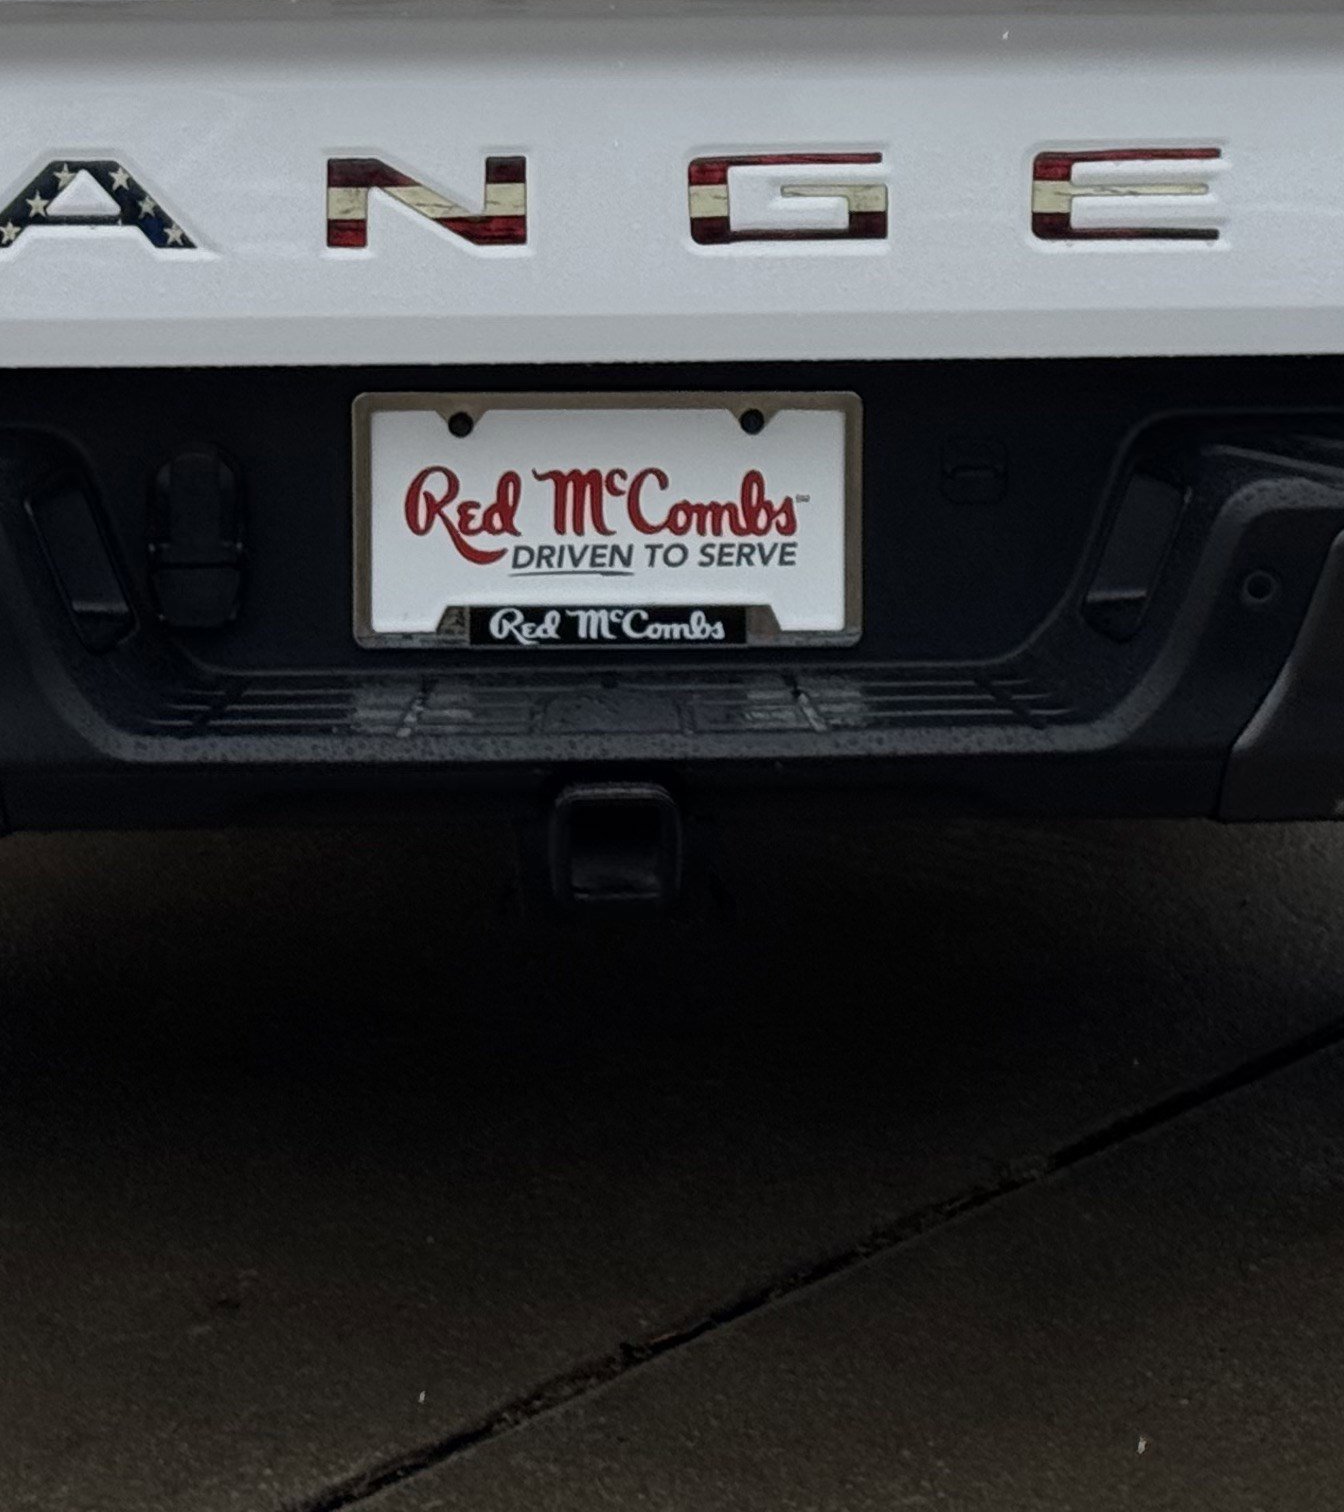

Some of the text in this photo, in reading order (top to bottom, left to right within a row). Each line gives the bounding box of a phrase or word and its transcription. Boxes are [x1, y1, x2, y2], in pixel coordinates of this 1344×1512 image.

[404, 465, 799, 566] Red McCombs
[510, 541, 799, 570] DRIVEN TO SERVE
[489, 607, 726, 645] Red McCombs
